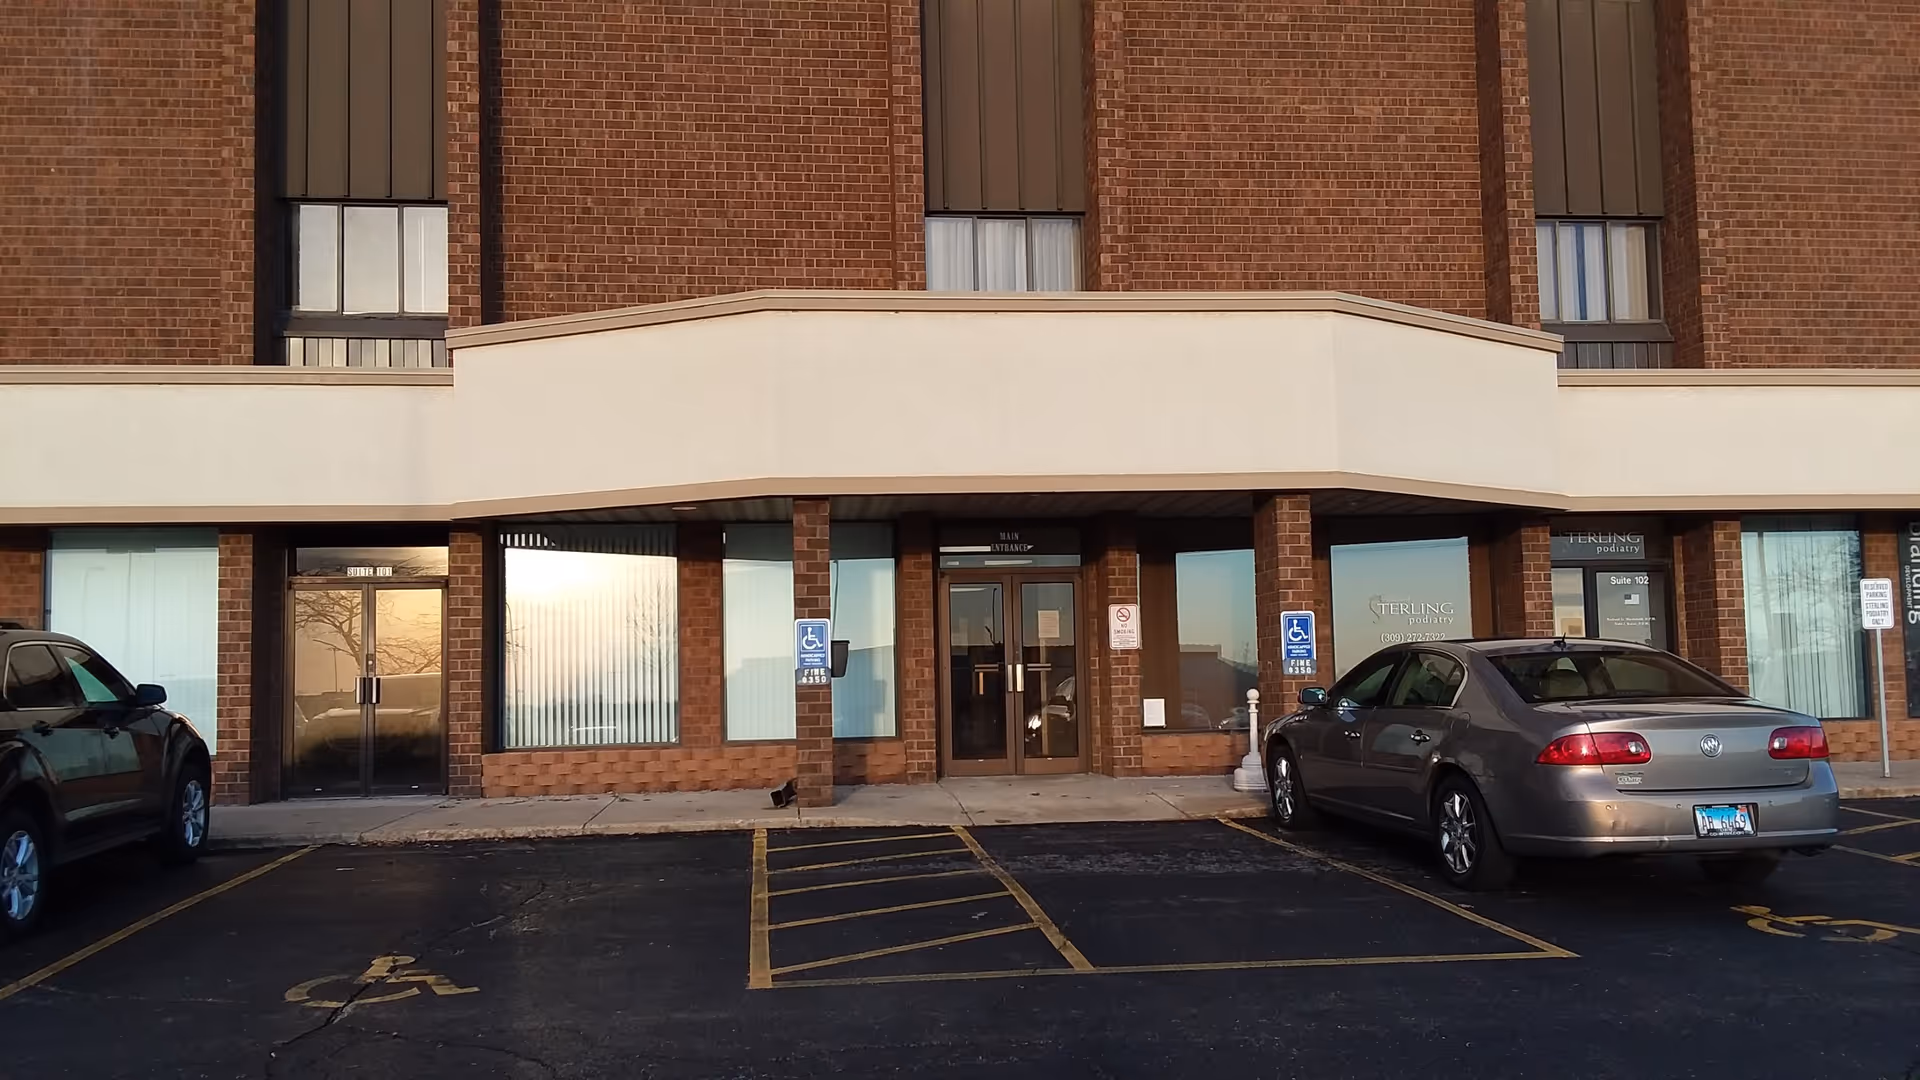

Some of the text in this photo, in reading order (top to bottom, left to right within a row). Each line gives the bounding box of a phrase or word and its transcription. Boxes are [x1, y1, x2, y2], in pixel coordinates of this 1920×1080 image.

[1000, 532, 1019, 541] MAIN
[1564, 532, 1640, 543] TERLING
[991, 543, 1028, 552] ENTRANCE
[1596, 543, 1640, 554] podiatry
[347, 567, 392, 576] SUITE 101
[1610, 575, 1650, 585] Suite 102
[1904, 565, 1913, 609] DEVELOPMENT
[1408, 614, 1454, 625] podiatry
[1381, 632, 1446, 643] (309) 272-7322
[1720, 814, 1747, 830] 6469
